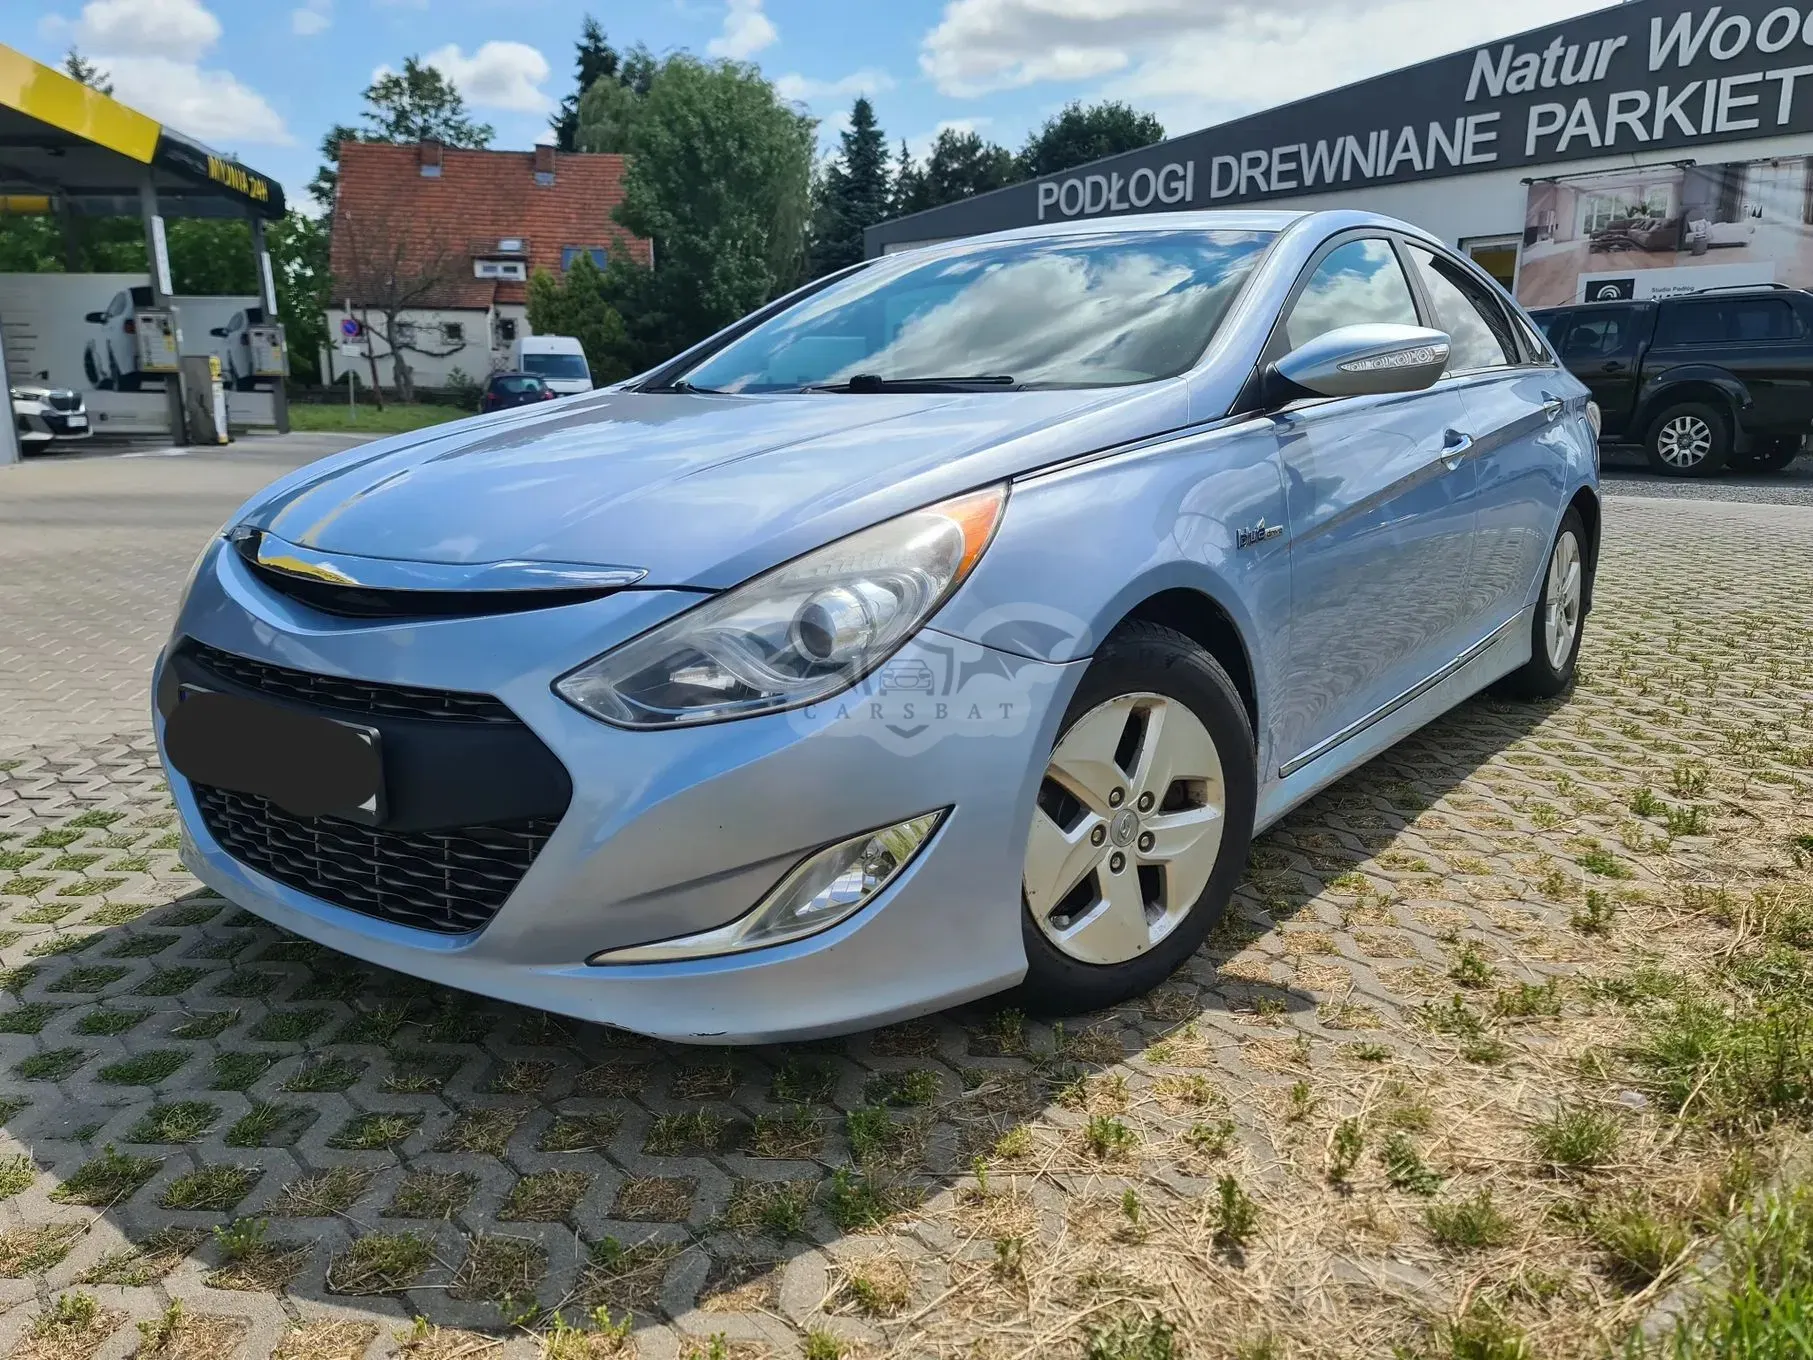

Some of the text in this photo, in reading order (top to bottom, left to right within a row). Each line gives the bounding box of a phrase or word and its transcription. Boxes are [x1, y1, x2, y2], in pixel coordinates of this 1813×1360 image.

[1464, 6, 1813, 102] Natur Woo
[1038, 65, 1813, 220] PODŁOGI DREWNIANE PARKIET
